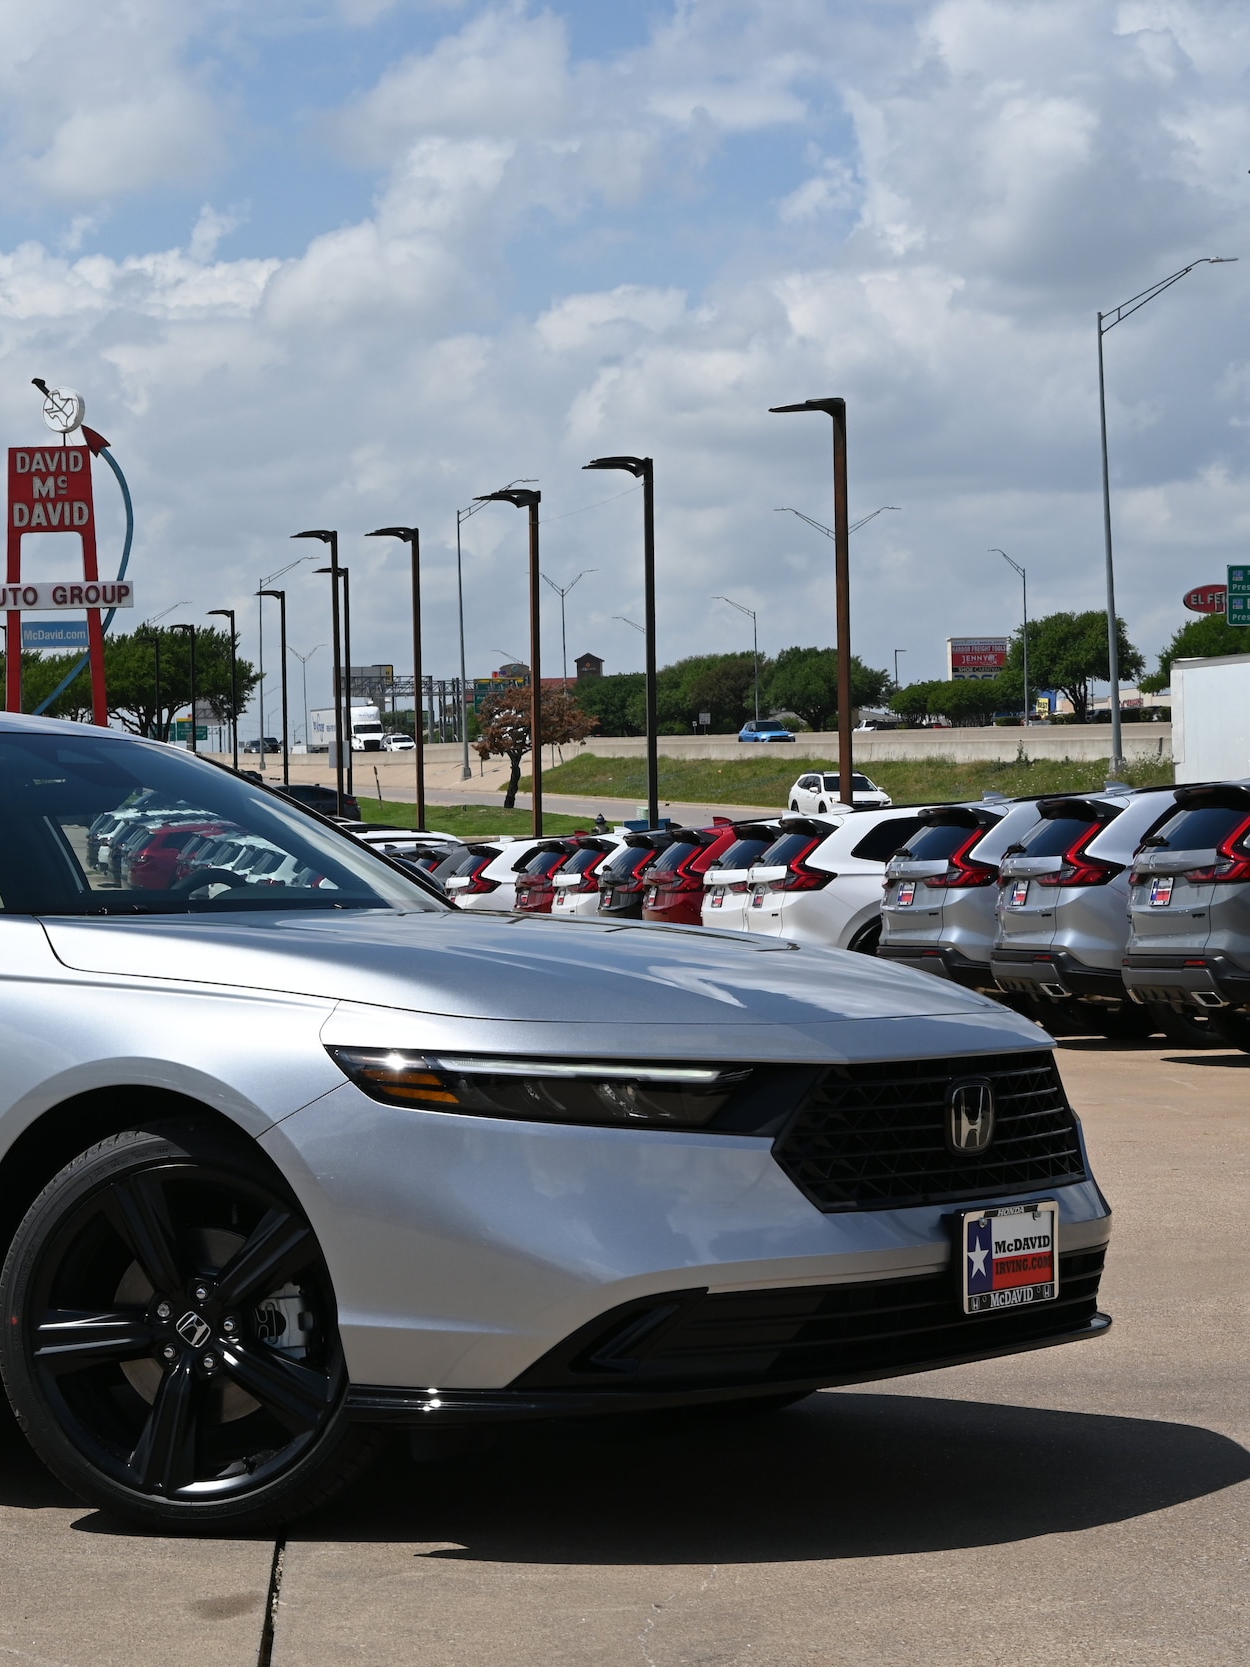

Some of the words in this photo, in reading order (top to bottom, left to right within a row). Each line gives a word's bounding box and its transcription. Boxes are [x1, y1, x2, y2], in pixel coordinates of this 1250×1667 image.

[16, 451, 83, 474] DAVID
[13, 502, 89, 527] DAVID
[52, 584, 130, 606] GROUP
[1191, 594, 1205, 605] EL
[24, 630, 86, 641] McDavid.com
[997, 1206, 1025, 1217] HONDA
[995, 1235, 1050, 1254] McDAVID
[996, 1256, 1053, 1275] IRVING.COM
[990, 1287, 1034, 1308] McDAVID
